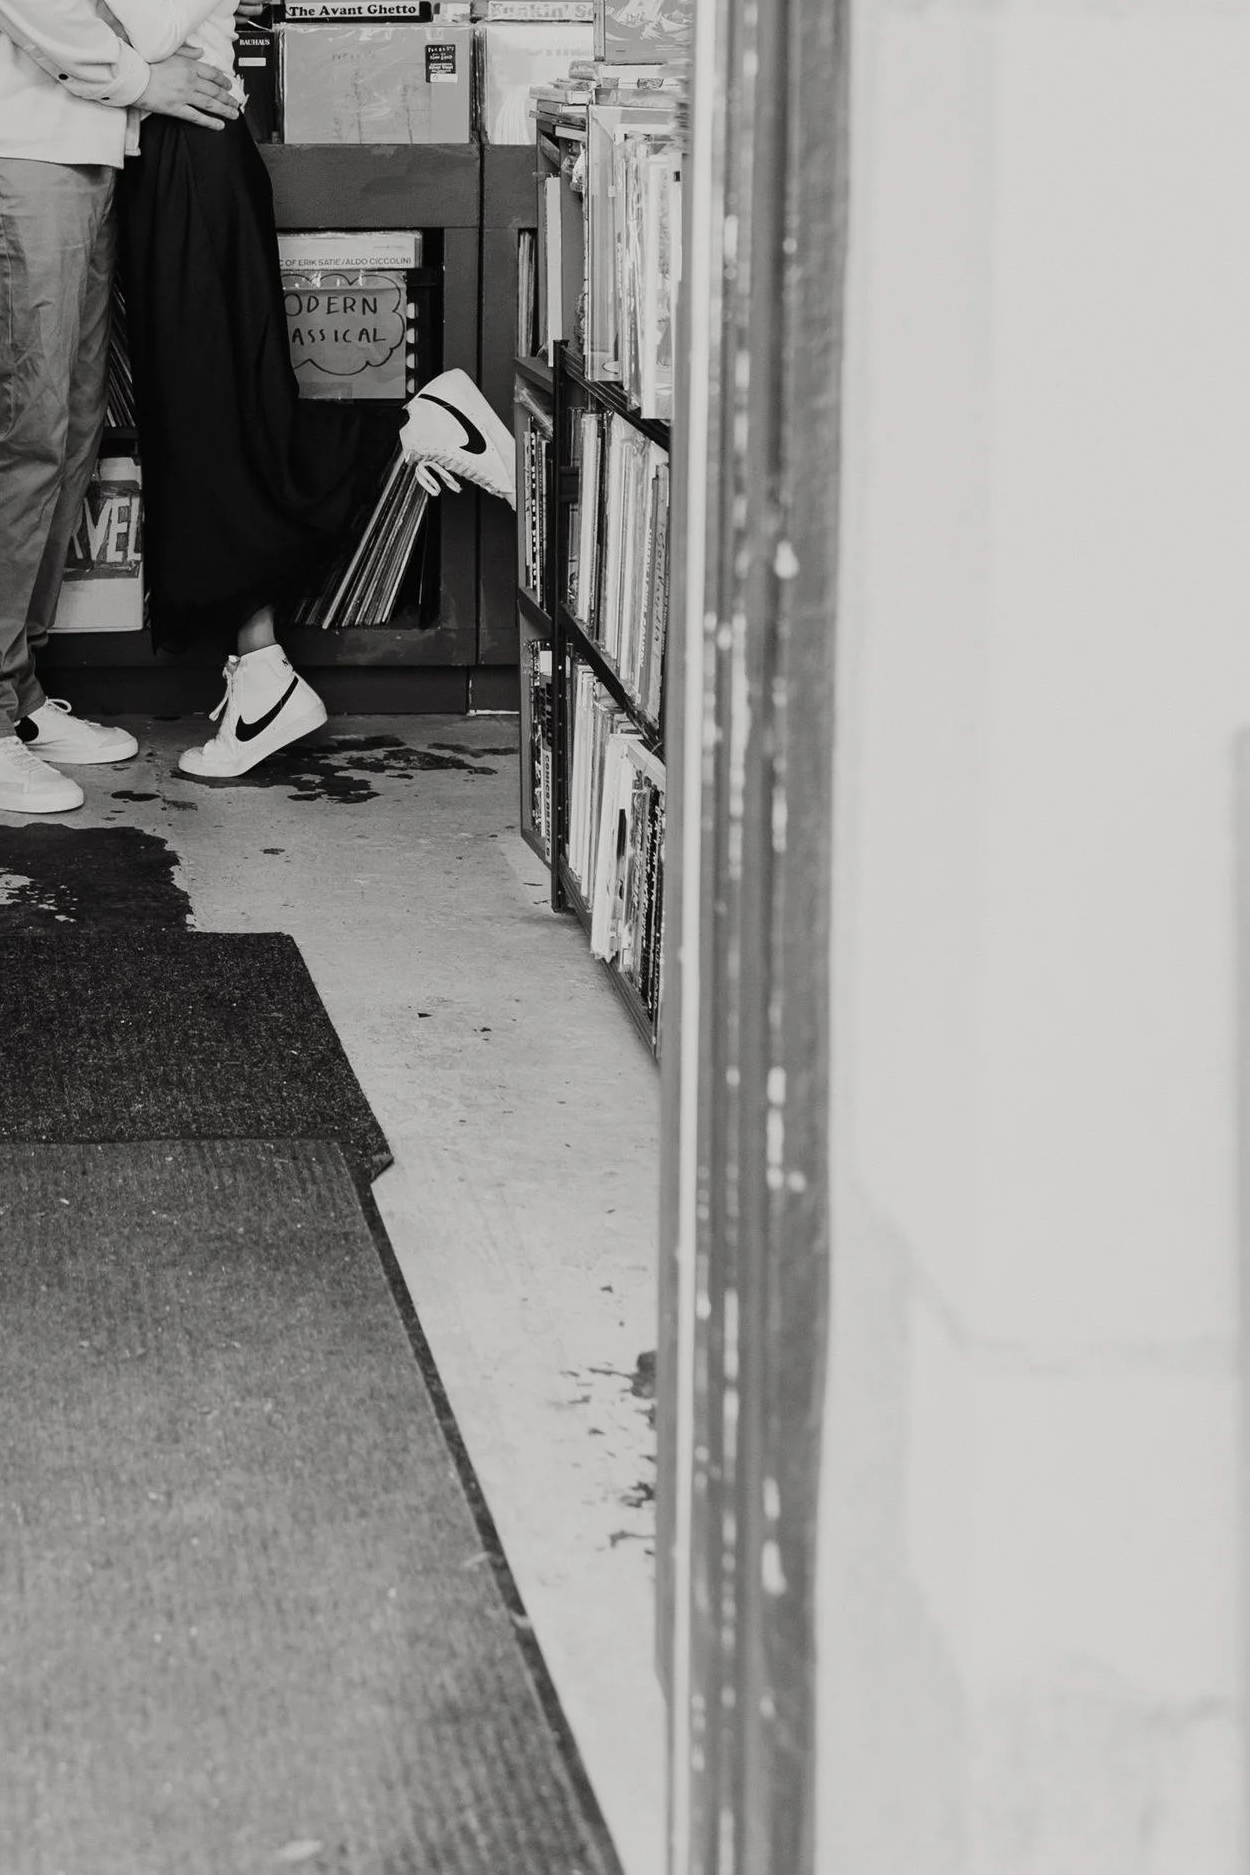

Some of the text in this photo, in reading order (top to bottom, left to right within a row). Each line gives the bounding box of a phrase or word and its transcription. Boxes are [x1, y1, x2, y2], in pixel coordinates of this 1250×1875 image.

[288, 4, 417, 17] The Avant Ghetto
[239, 38, 271, 46] BAUHAUS
[285, 259, 297, 267] OF
[298, 258, 317, 266] ERIK
[369, 256, 412, 265] CICCOLINI
[284, 293, 379, 317] ODERN
[291, 327, 387, 346] ASSICAL
